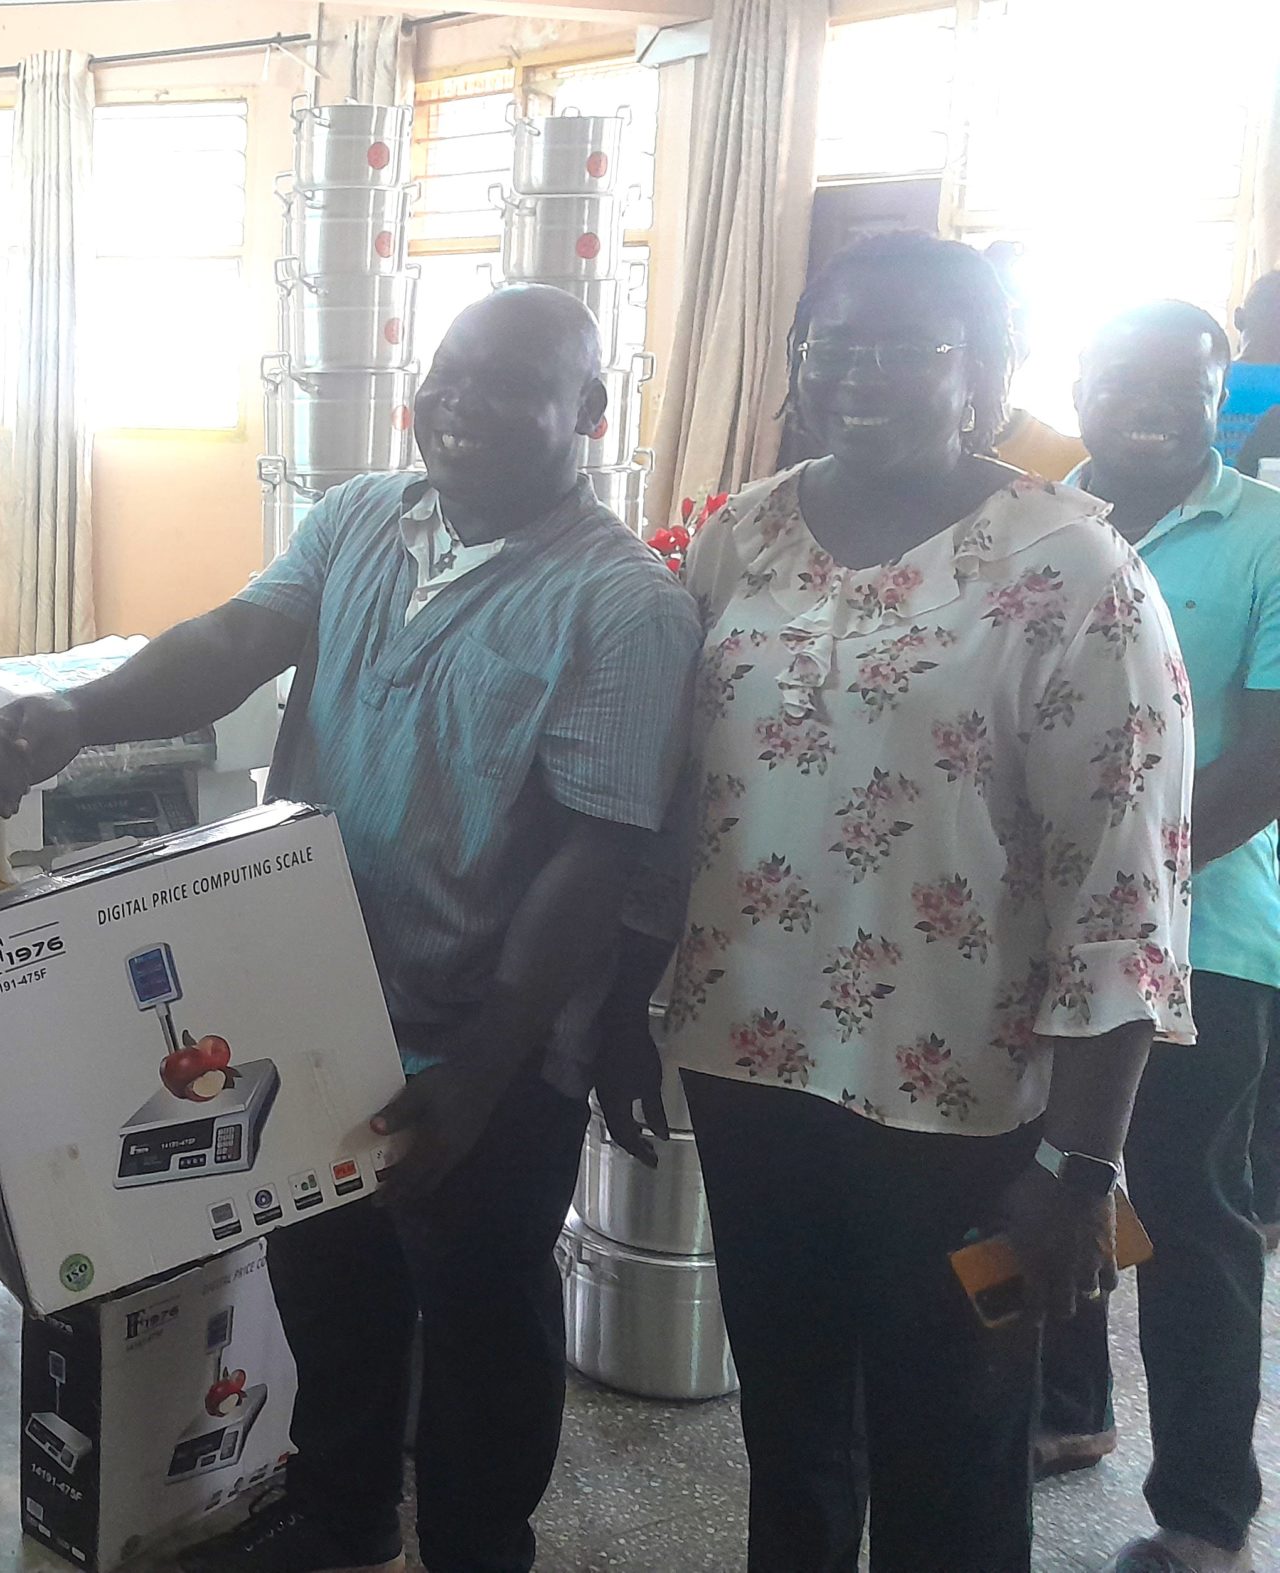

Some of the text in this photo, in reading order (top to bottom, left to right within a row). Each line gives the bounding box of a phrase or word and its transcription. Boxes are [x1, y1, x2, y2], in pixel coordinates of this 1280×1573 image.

[97, 847, 314, 925] DIGITAL PRICE COMPUTING SCALE
[66, 1263, 88, 1283] ISO
